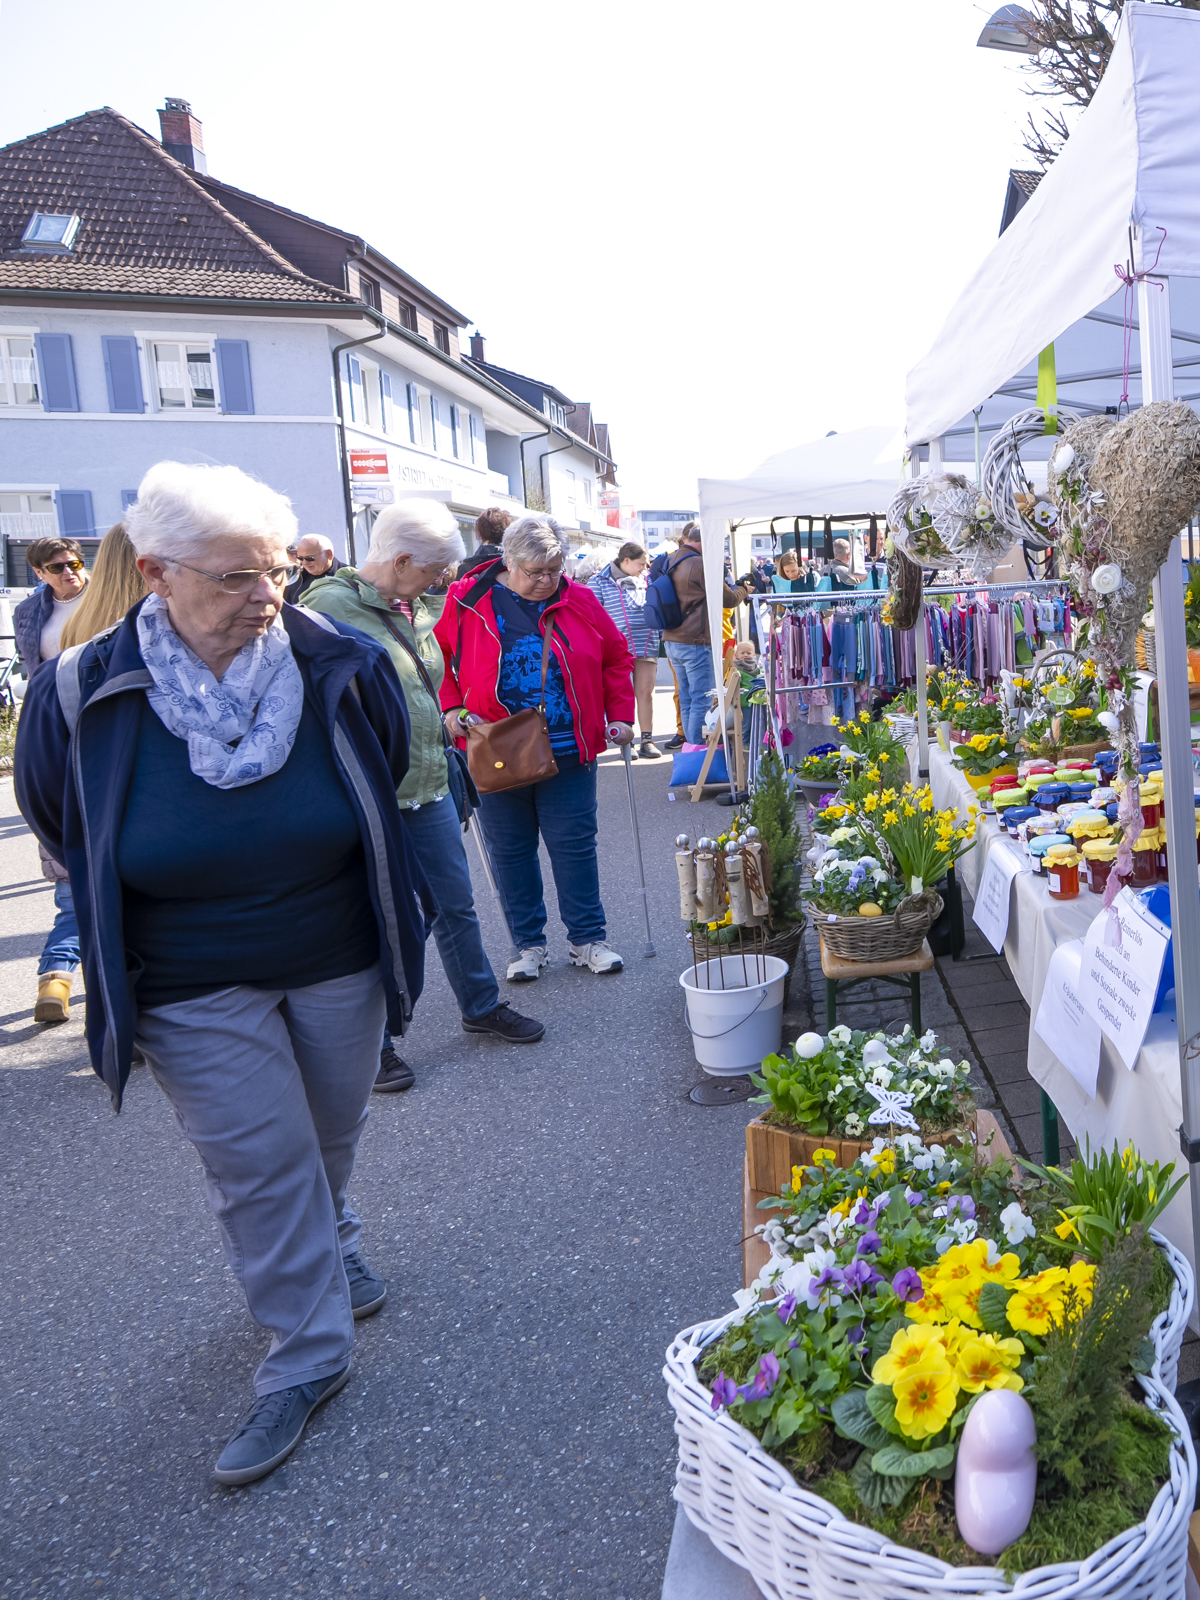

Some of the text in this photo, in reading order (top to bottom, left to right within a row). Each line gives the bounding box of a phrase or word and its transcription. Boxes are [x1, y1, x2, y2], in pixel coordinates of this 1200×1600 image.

[1120, 917, 1144, 946] Reinerlös
[1094, 946, 1142, 997] Behinderte Kinder
[1123, 950, 1131, 962] an
[1090, 968, 1100, 983] und
[1100, 975, 1118, 1002] Soziale
[1097, 998, 1122, 1032] Gespendet
